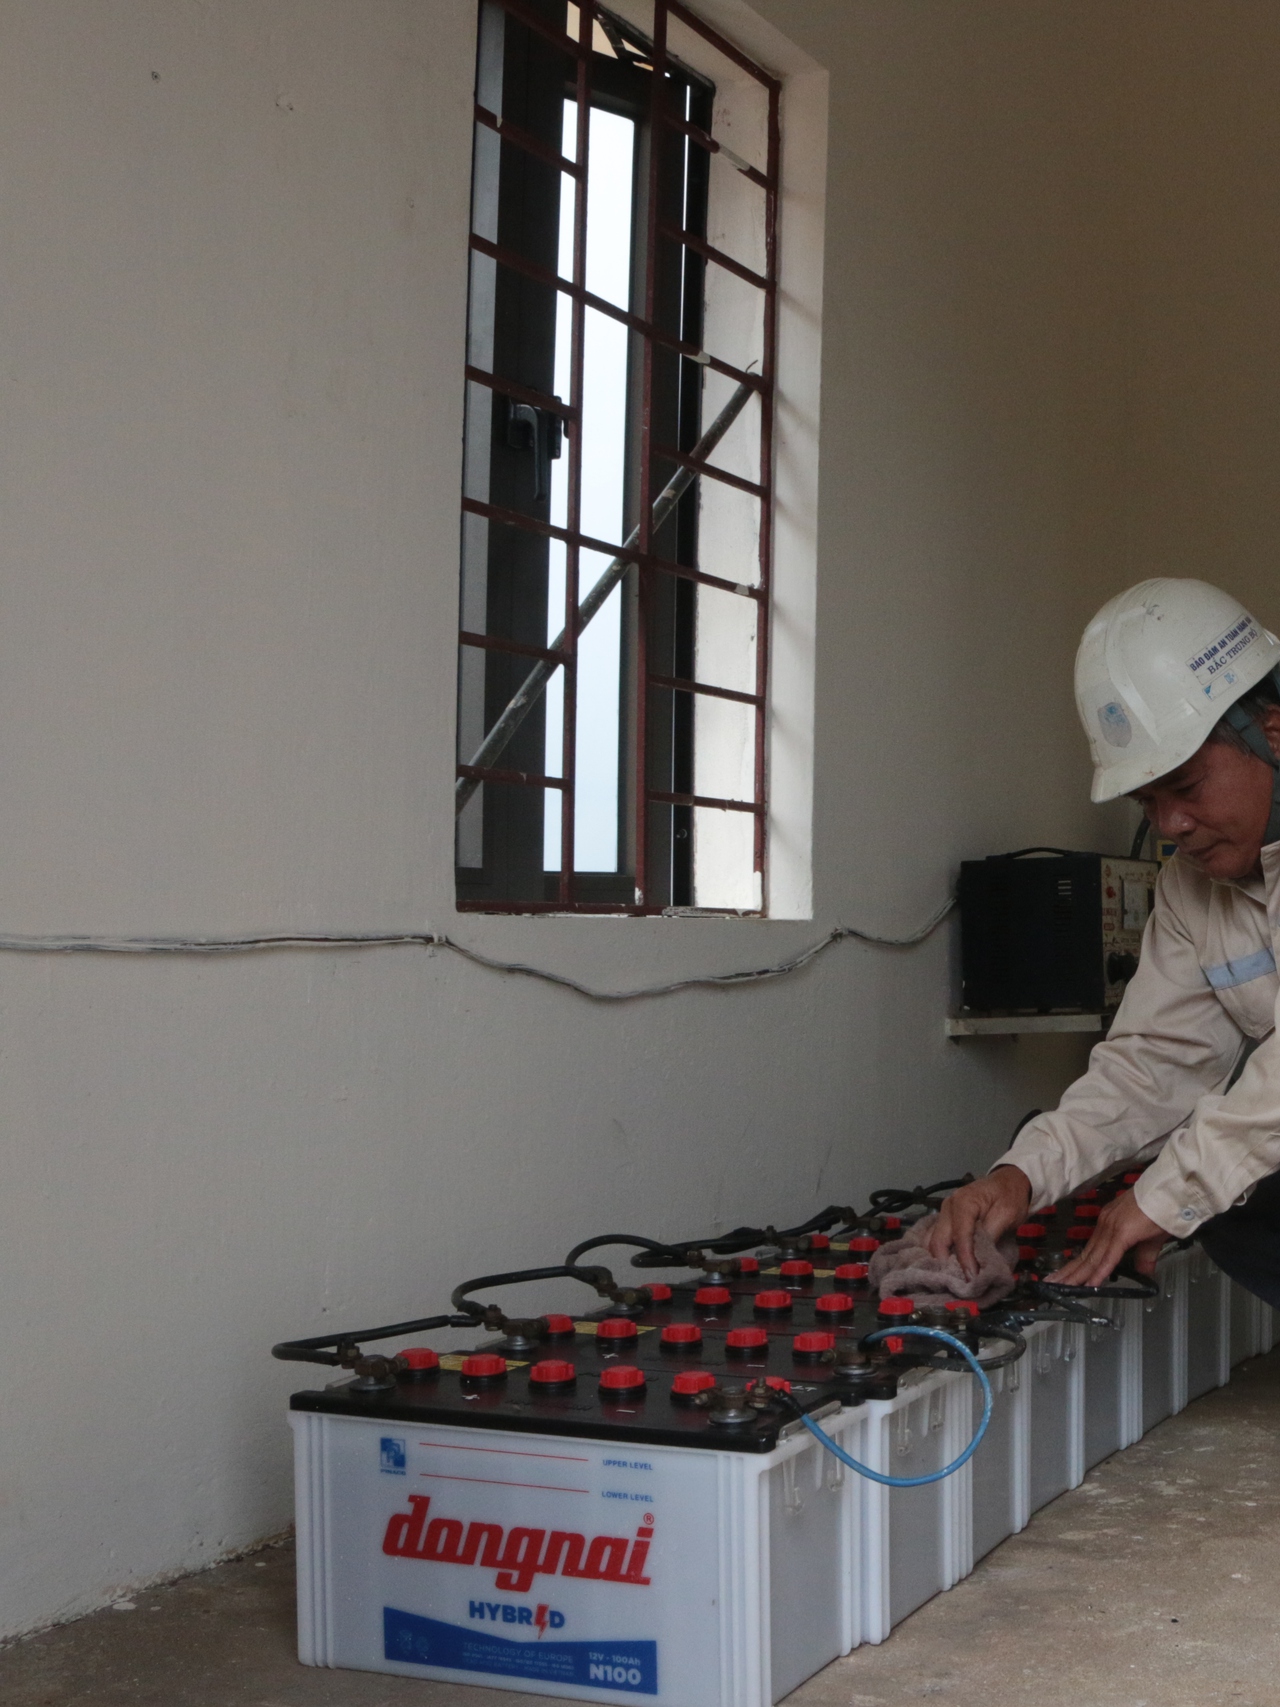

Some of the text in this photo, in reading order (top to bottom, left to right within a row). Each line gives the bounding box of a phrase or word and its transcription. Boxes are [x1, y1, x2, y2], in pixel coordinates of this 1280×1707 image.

[1217, 638, 1228, 650] AN
[1226, 635, 1251, 659] TRUNG
[602, 1459, 653, 1471] UPPER LEVEL
[601, 1491, 654, 1503] LOWER LEVEL
[382, 1495, 654, 1592] dongnai
[463, 1641, 573, 1663] TECHNOLOGY OF EUROPE
[588, 1651, 604, 1661] 12V
[612, 1655, 641, 1666] 100Ah
[589, 1663, 642, 1686] N100
